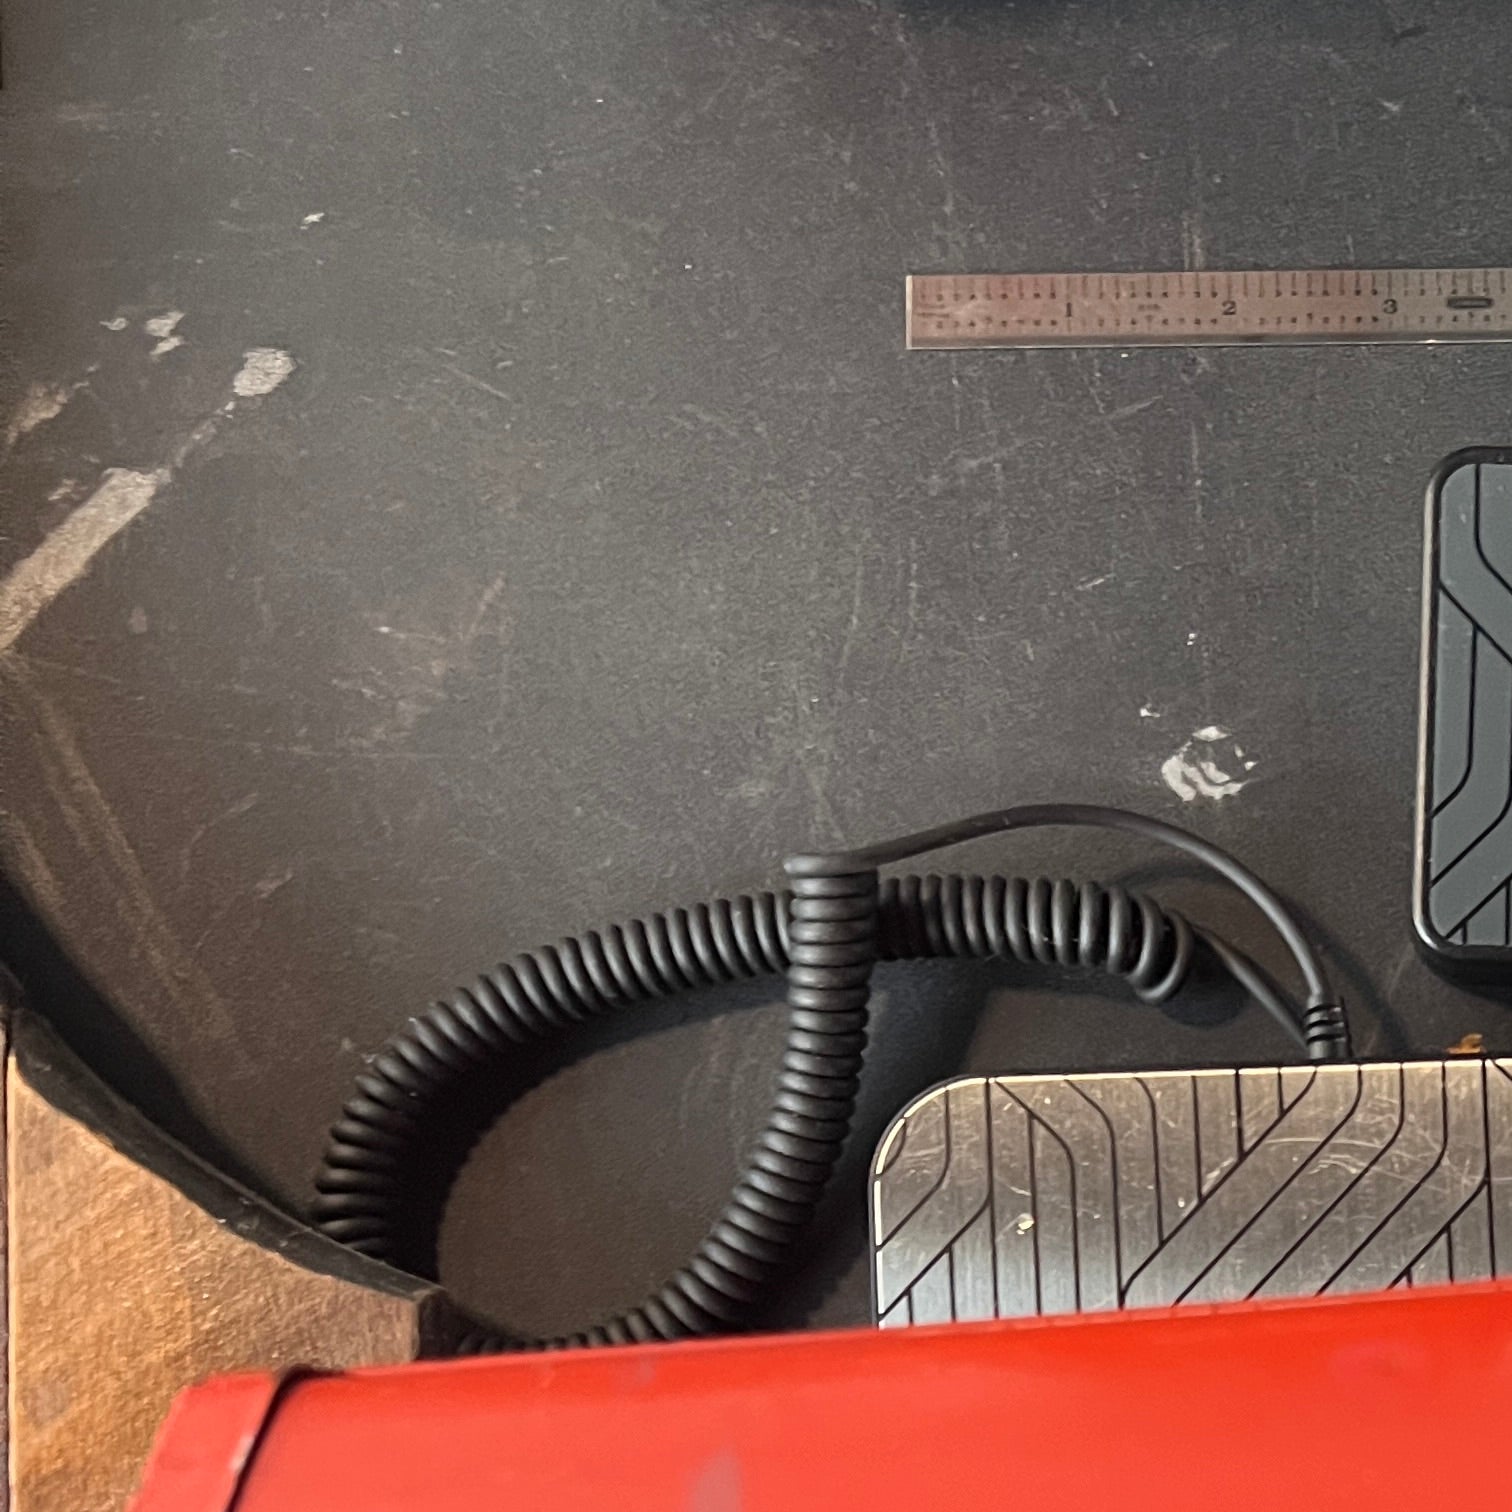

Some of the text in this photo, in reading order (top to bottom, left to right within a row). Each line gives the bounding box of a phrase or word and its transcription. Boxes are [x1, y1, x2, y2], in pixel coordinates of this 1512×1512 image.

[1065, 302, 1073, 317] 1
[1221, 300, 1237, 316] 2
[1383, 298, 1398, 314] 3
